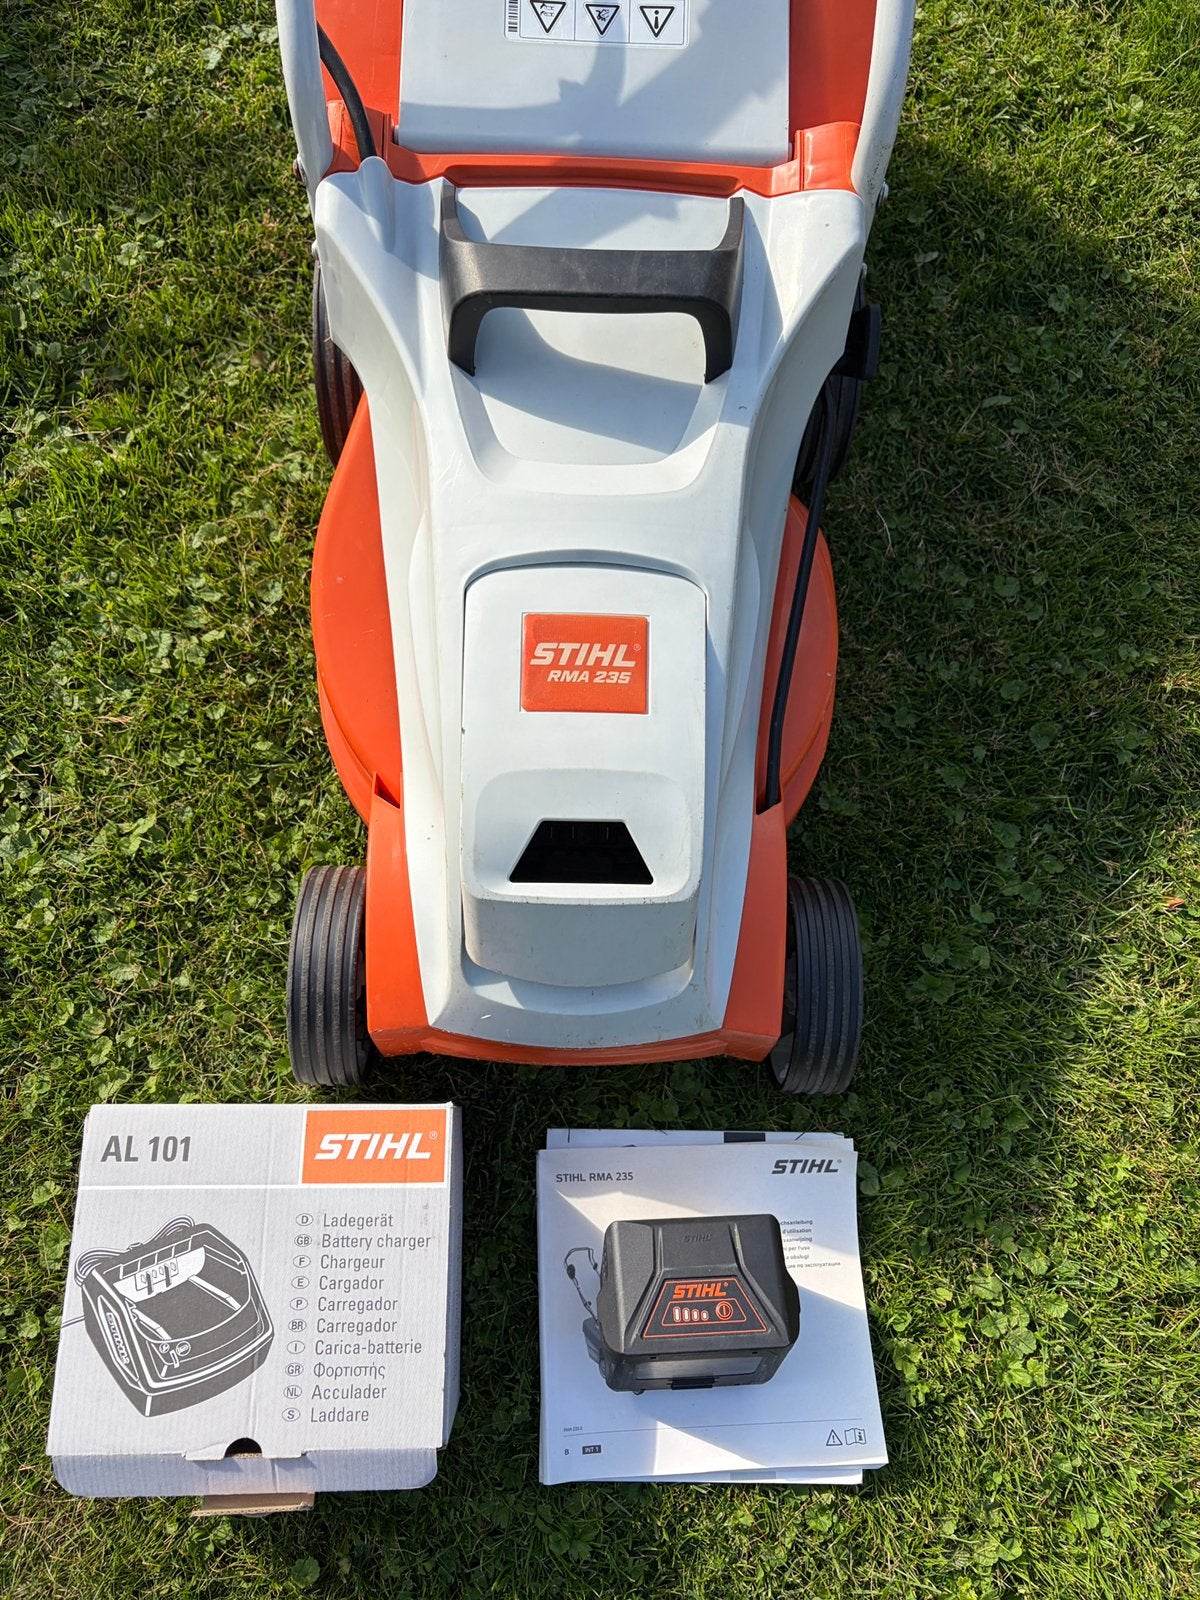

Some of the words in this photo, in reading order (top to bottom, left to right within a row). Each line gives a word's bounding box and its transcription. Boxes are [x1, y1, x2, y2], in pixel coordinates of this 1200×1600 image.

[529, 642, 636, 667] STIHL
[547, 670, 589, 683] RMA
[593, 671, 631, 684] 235
[100, 1135, 139, 1162] AL
[148, 1135, 191, 1162] 101
[313, 1132, 432, 1160] STIHL
[771, 1159, 839, 1175] STIHL
[555, 1173, 586, 1183] STIHL
[589, 1172, 613, 1182] RMA
[616, 1171, 634, 1181] 235
[323, 1213, 394, 1230] Ladegerät
[321, 1233, 373, 1251] Battery
[376, 1234, 431, 1251] charger
[320, 1254, 385, 1272] Chargeur
[319, 1275, 384, 1293] Cargador
[672, 1283, 727, 1299] STIHL
[318, 1296, 398, 1314] Carregador
[316, 1317, 397, 1336] Carregador
[315, 1339, 422, 1355] Carica-batterie
[313, 1361, 385, 1380] Φορτιστής
[311, 1383, 387, 1399] Acculader
[310, 1406, 369, 1422] Laddare
